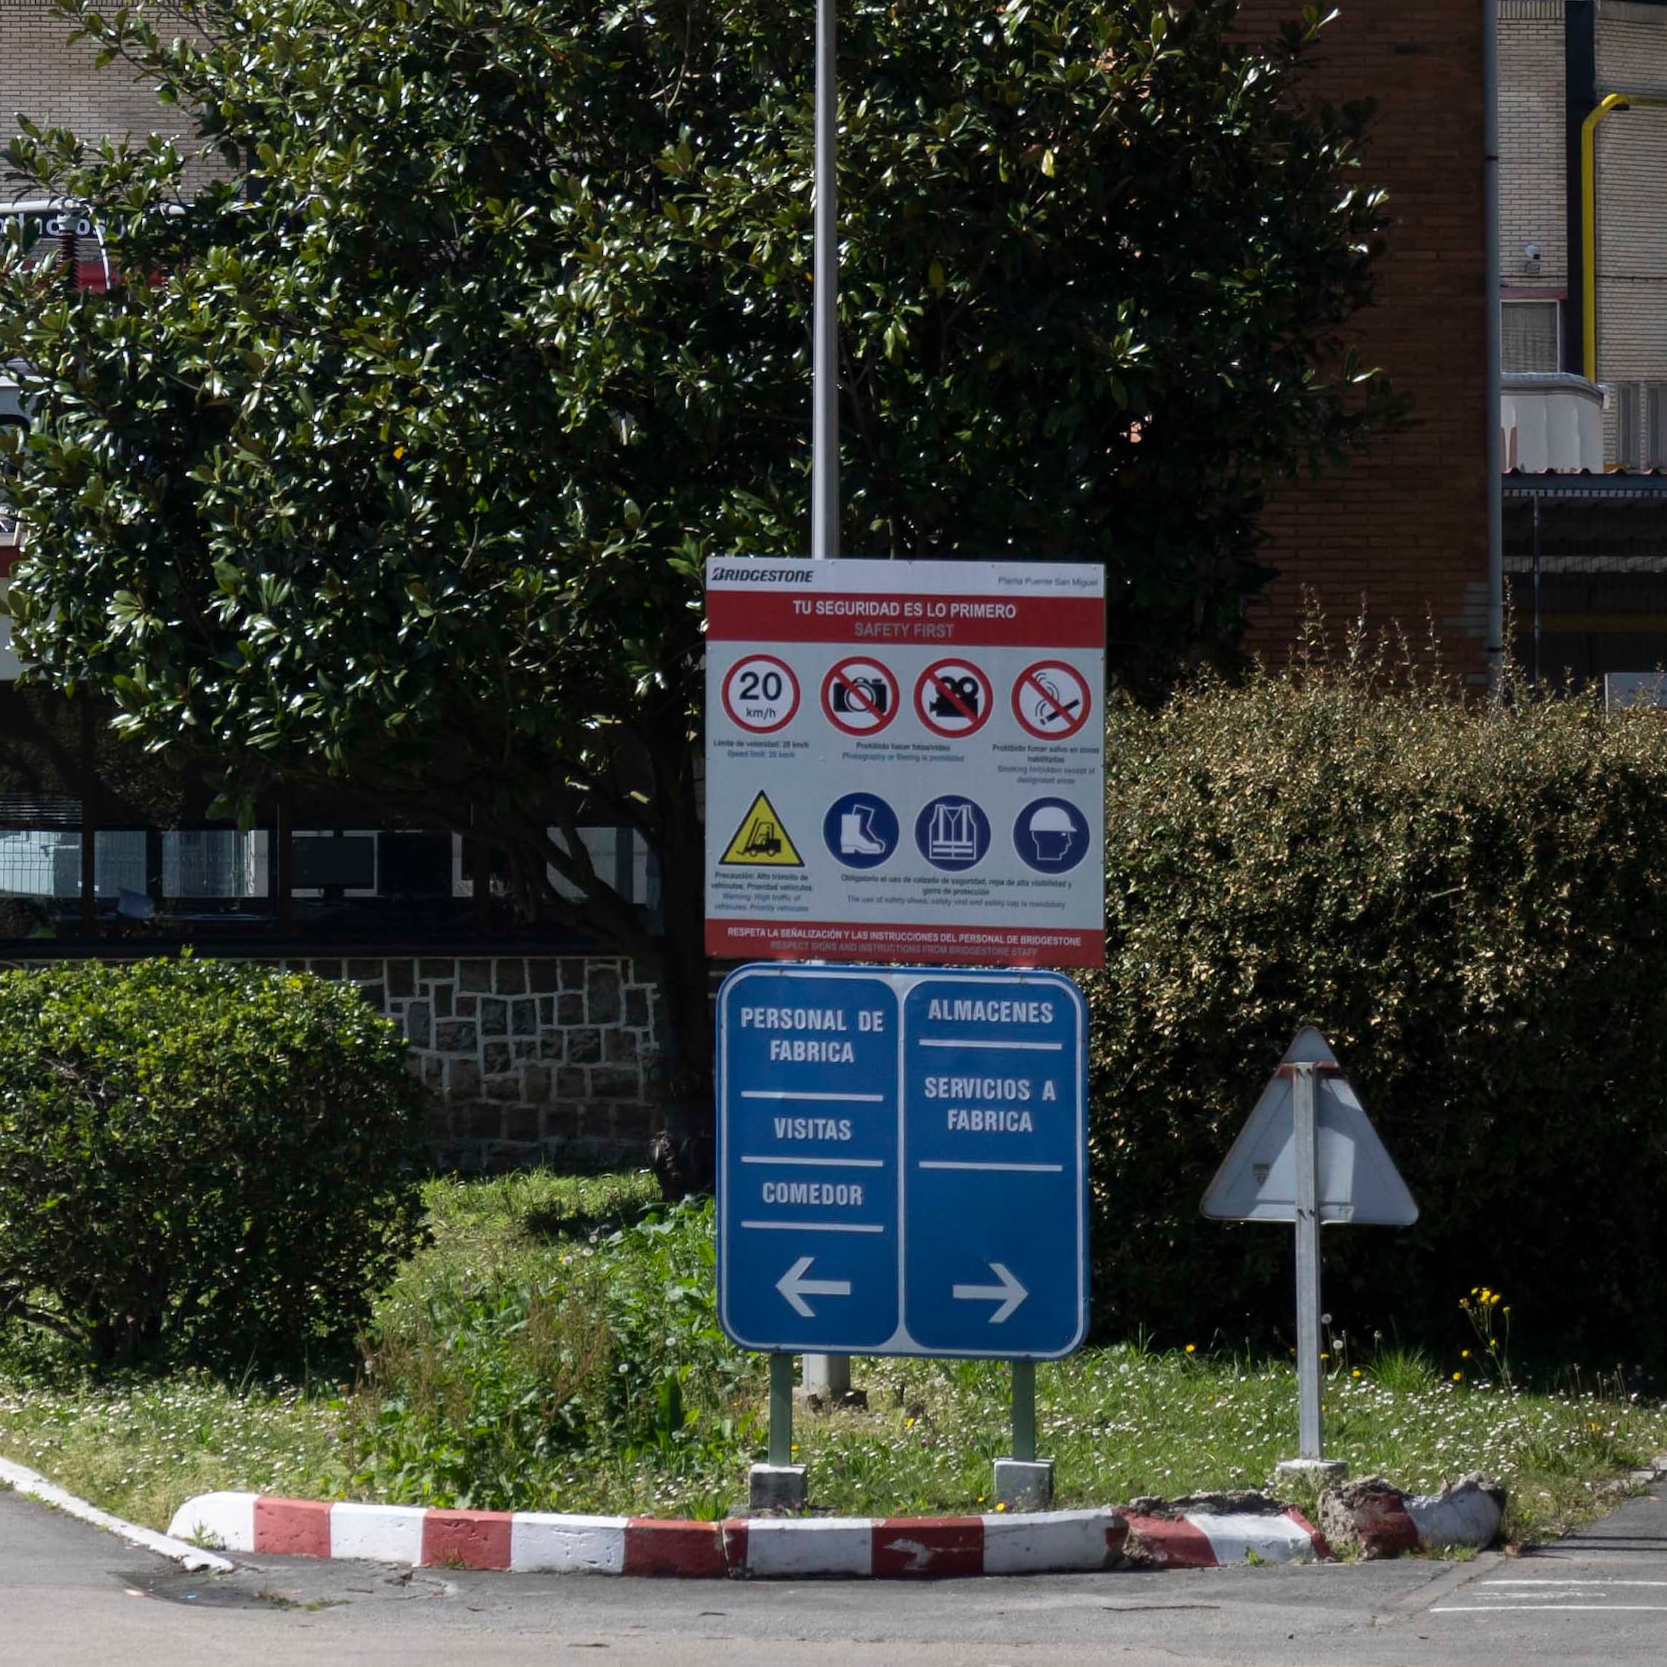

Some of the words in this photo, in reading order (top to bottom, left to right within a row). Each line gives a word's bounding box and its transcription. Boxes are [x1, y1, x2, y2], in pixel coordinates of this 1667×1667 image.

[712, 567, 814, 583] BRIDGESTONE
[793, 600, 811, 614] TU
[816, 600, 899, 616] SEGURIDAD
[904, 603, 923, 617] ES
[927, 603, 946, 618] LO
[950, 603, 1016, 619] PRIMERO
[854, 623, 910, 637] SAFETY
[914, 624, 954, 638] FIRST
[739, 671, 782, 701] 20
[746, 708, 776, 720] km/h
[727, 927, 766, 937] RESPETA
[767, 928, 779, 938] LA
[844, 931, 850, 939] Y
[852, 930, 868, 940] LAS
[870, 931, 939, 943] INSTRUCCIONES
[940, 933, 957, 943] DEL
[959, 933, 1005, 944] PERSONAL
[1007, 935, 1019, 944] DE
[1020, 935, 1082, 946] BRIDGESTONE
[740, 1007, 846, 1032] PERSONAL
[859, 1010, 884, 1033] DE
[927, 999, 1053, 1024] ALMACENES
[770, 1040, 854, 1064] FABRICA
[924, 1077, 1031, 1102] SERVICIOS
[1042, 1079, 1056, 1102] A
[774, 1117, 852, 1142] VISITAS
[947, 1109, 1033, 1134] FABRICA
[762, 1182, 863, 1207] COMEDOR
